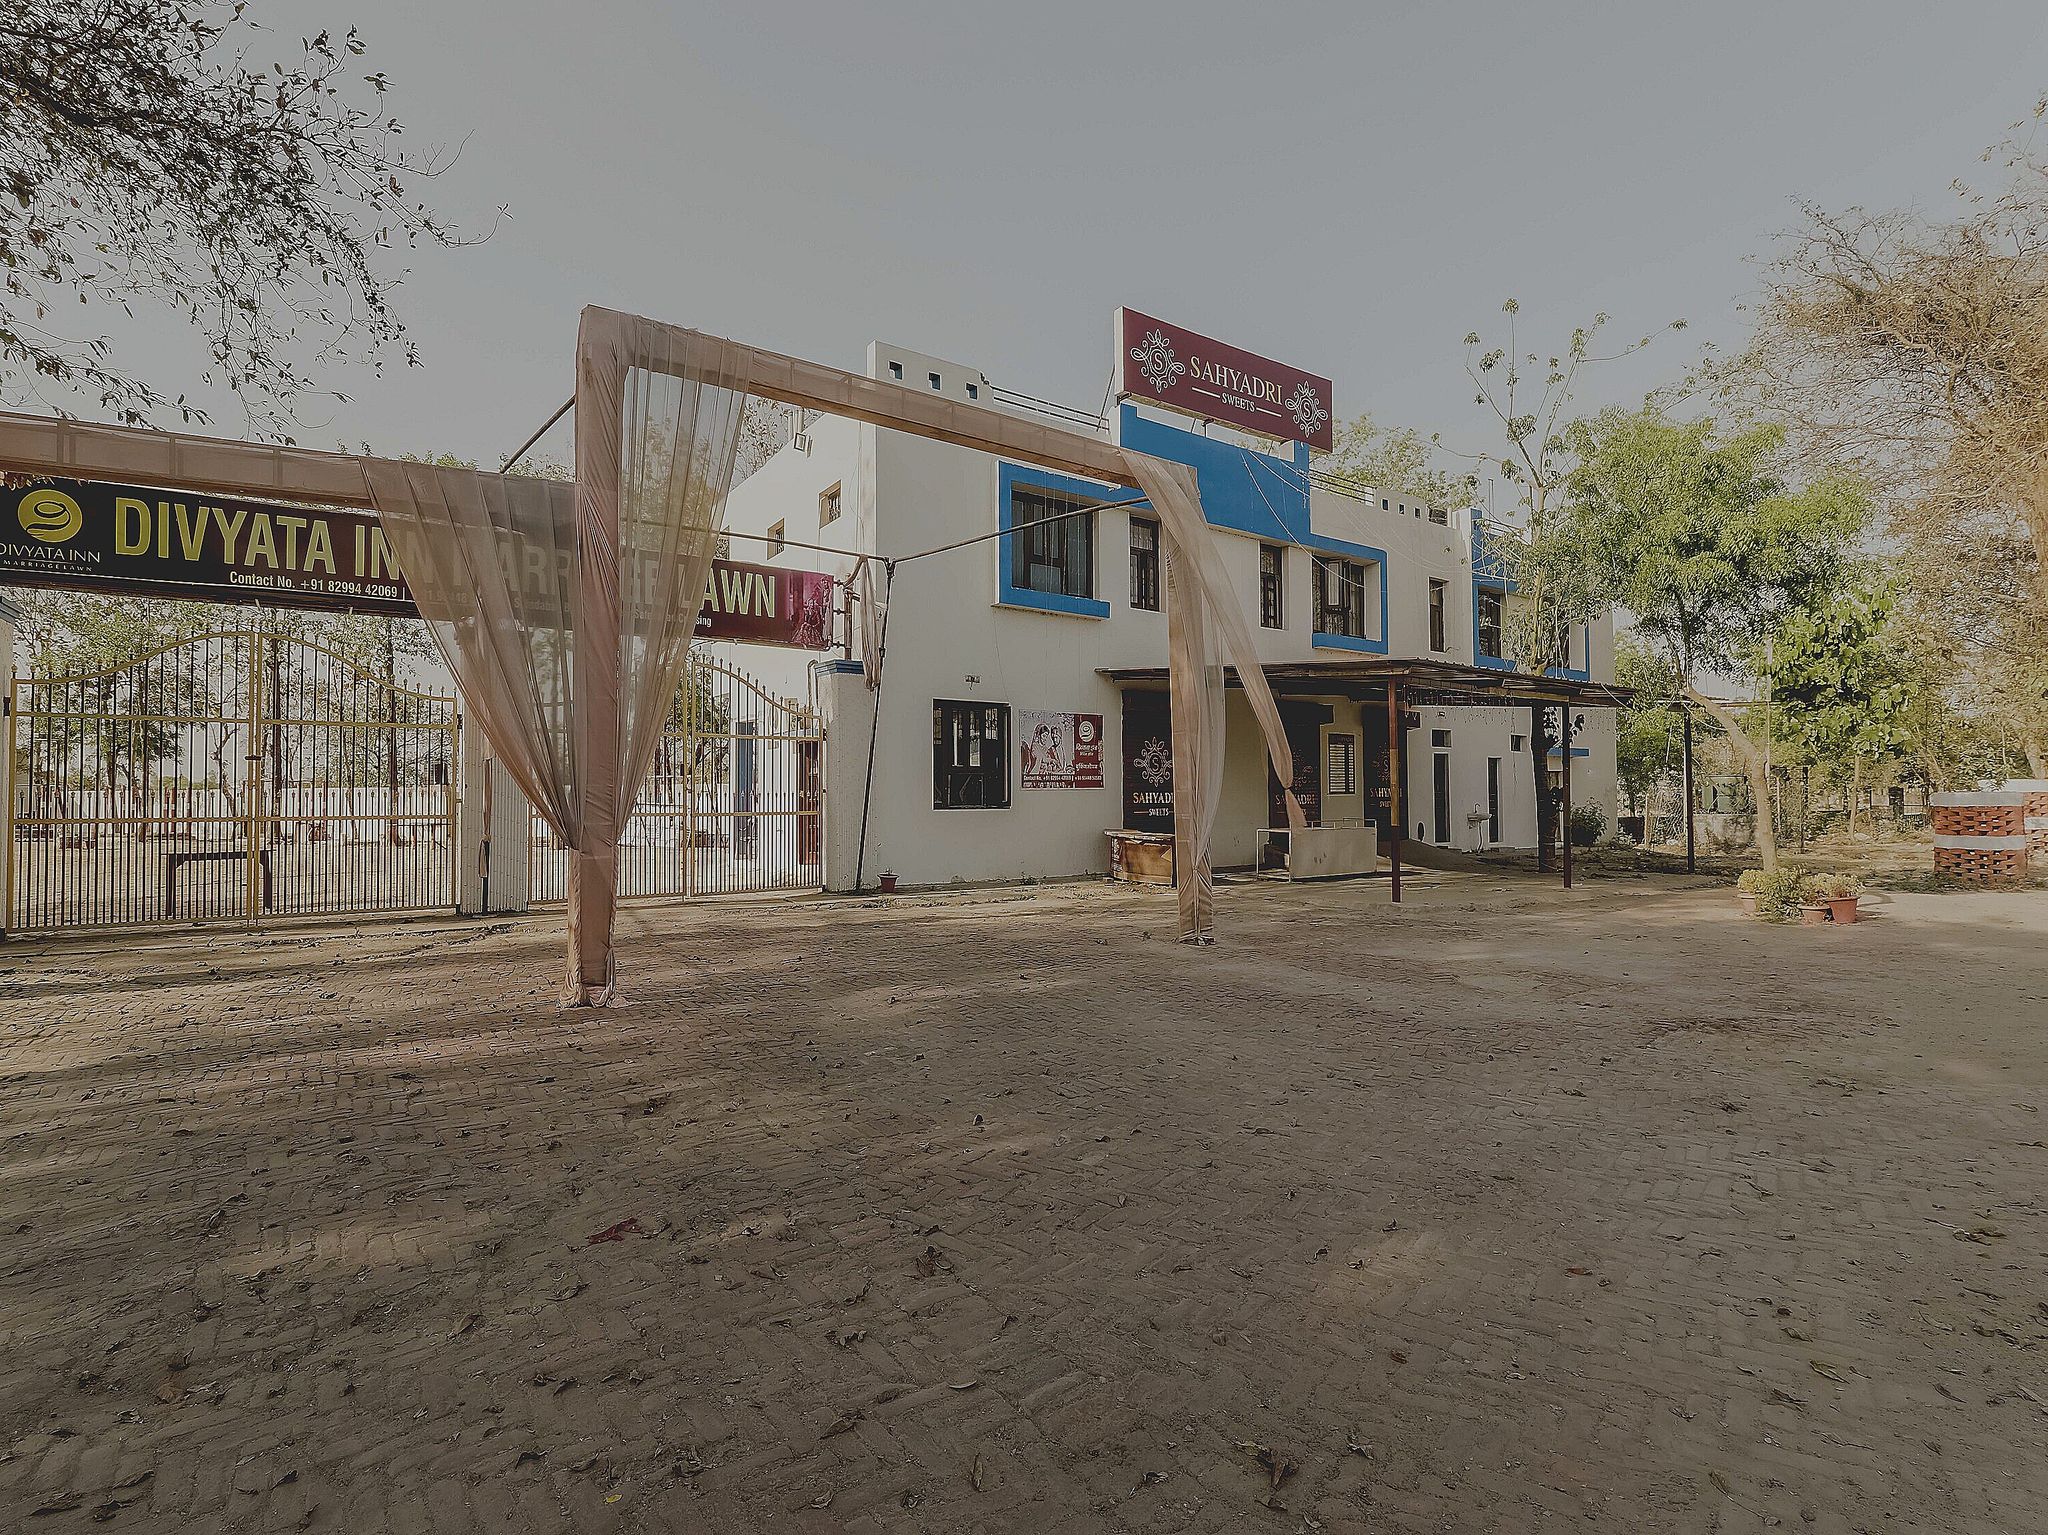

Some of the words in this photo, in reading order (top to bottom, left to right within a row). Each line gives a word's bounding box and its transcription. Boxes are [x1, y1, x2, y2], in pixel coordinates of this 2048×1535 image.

[1190, 356, 1283, 406] SAHYADRI
[1221, 392, 1256, 413] SWEETS
[69, 549, 100, 563] INN
[114, 496, 337, 575] DIVYATA
[677, 563, 776, 618] LAWN
[229, 571, 274, 587] Contact
[277, 574, 296, 589] No.
[300, 578, 324, 591] +91
[327, 580, 362, 594] 82994
[364, 585, 398, 598] 42069
[1133, 792, 1174, 804] SAHYAD
[1148, 807, 1170, 817] SWEETS
